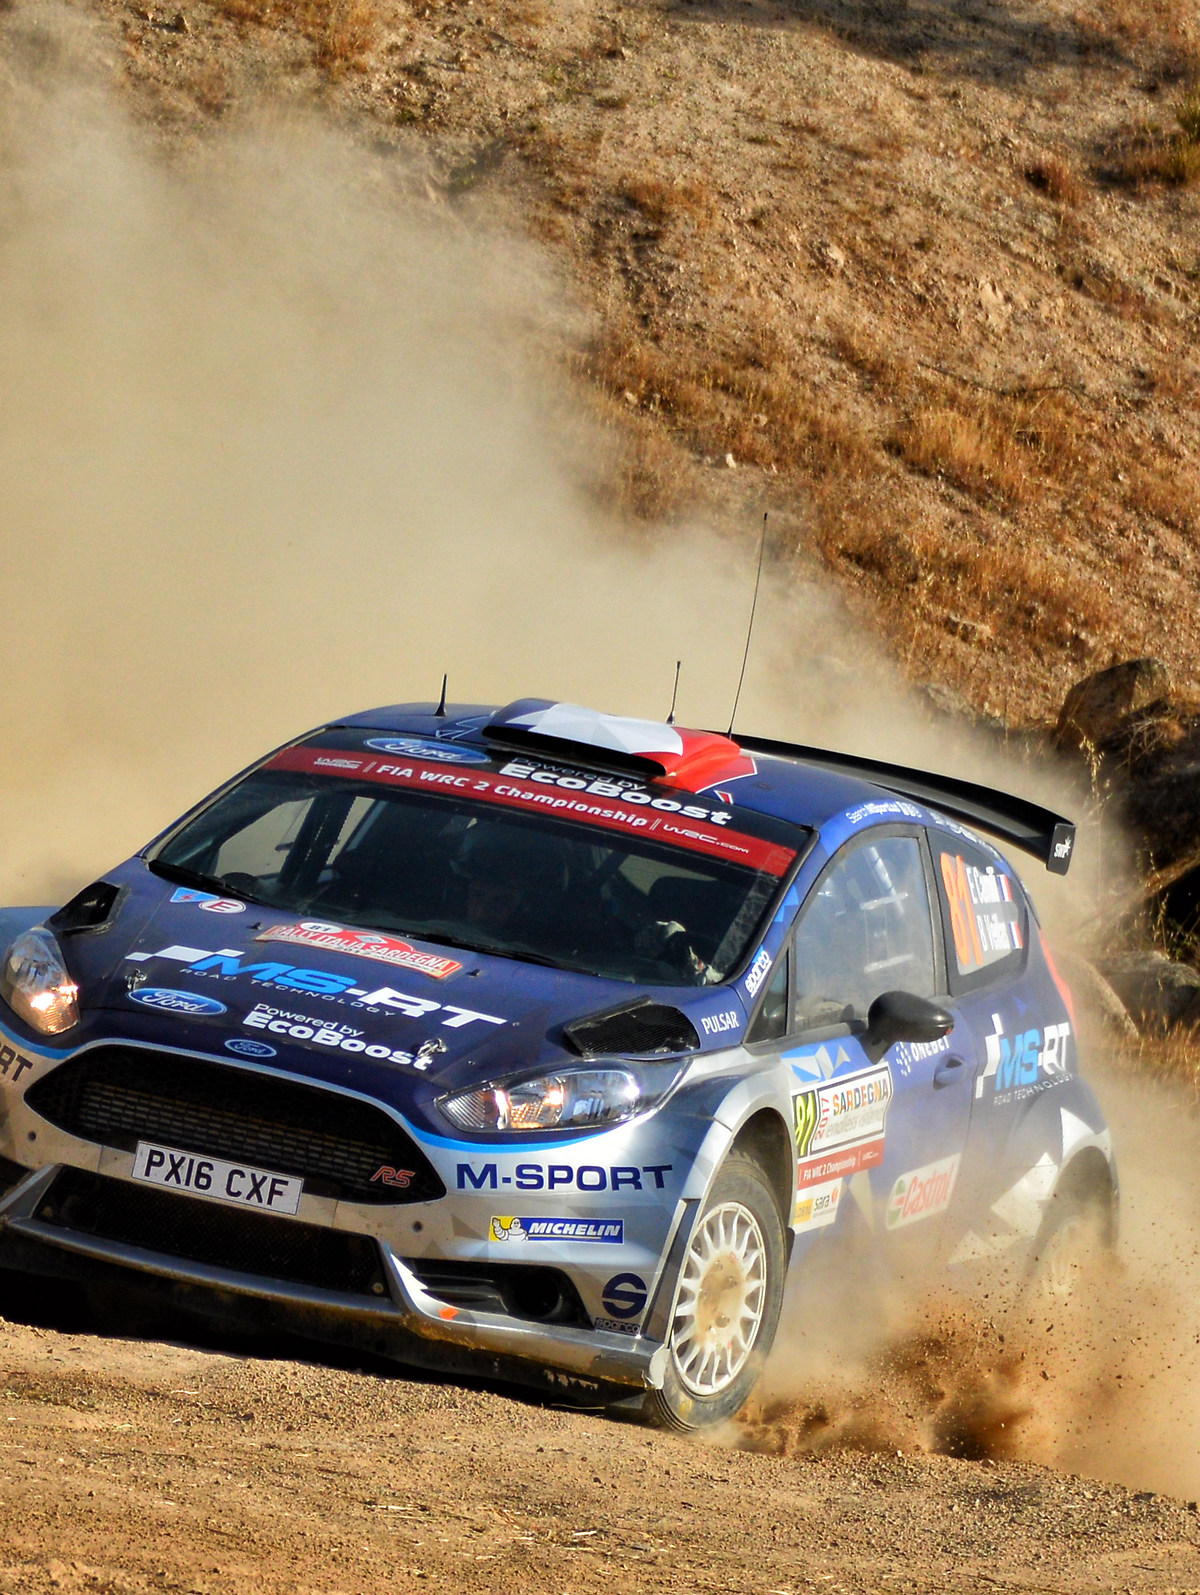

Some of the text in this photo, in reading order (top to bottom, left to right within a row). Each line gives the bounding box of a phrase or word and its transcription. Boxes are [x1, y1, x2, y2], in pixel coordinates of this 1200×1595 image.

[377, 764, 413, 778] FIA
[419, 770, 470, 786] WRC
[473, 780, 490, 791] 2
[494, 785, 647, 827] Championship
[499, 762, 733, 825] EcoBoost
[511, 757, 647, 791] Powered by
[274, 926, 452, 970] RALLY ITALIA SARDEGNA
[140, 989, 208, 1014] Ford
[180, 968, 396, 1017] ROAD TECHNOLOGY
[189, 955, 508, 1029] MS-RT
[242, 1011, 433, 1071] EcoBoost
[254, 1003, 365, 1038] Powered by
[701, 1011, 740, 1034] PULSAR
[995, 1022, 1070, 1091] MS-RT
[814, 1097, 830, 1141] 2017
[832, 1078, 890, 1116] SARDEGNA
[144, 1149, 289, 1206] PX16 CXF
[370, 1166, 416, 1188] RS
[456, 1163, 673, 1191] M-SPORT
[528, 1222, 621, 1238] MICHELIN
